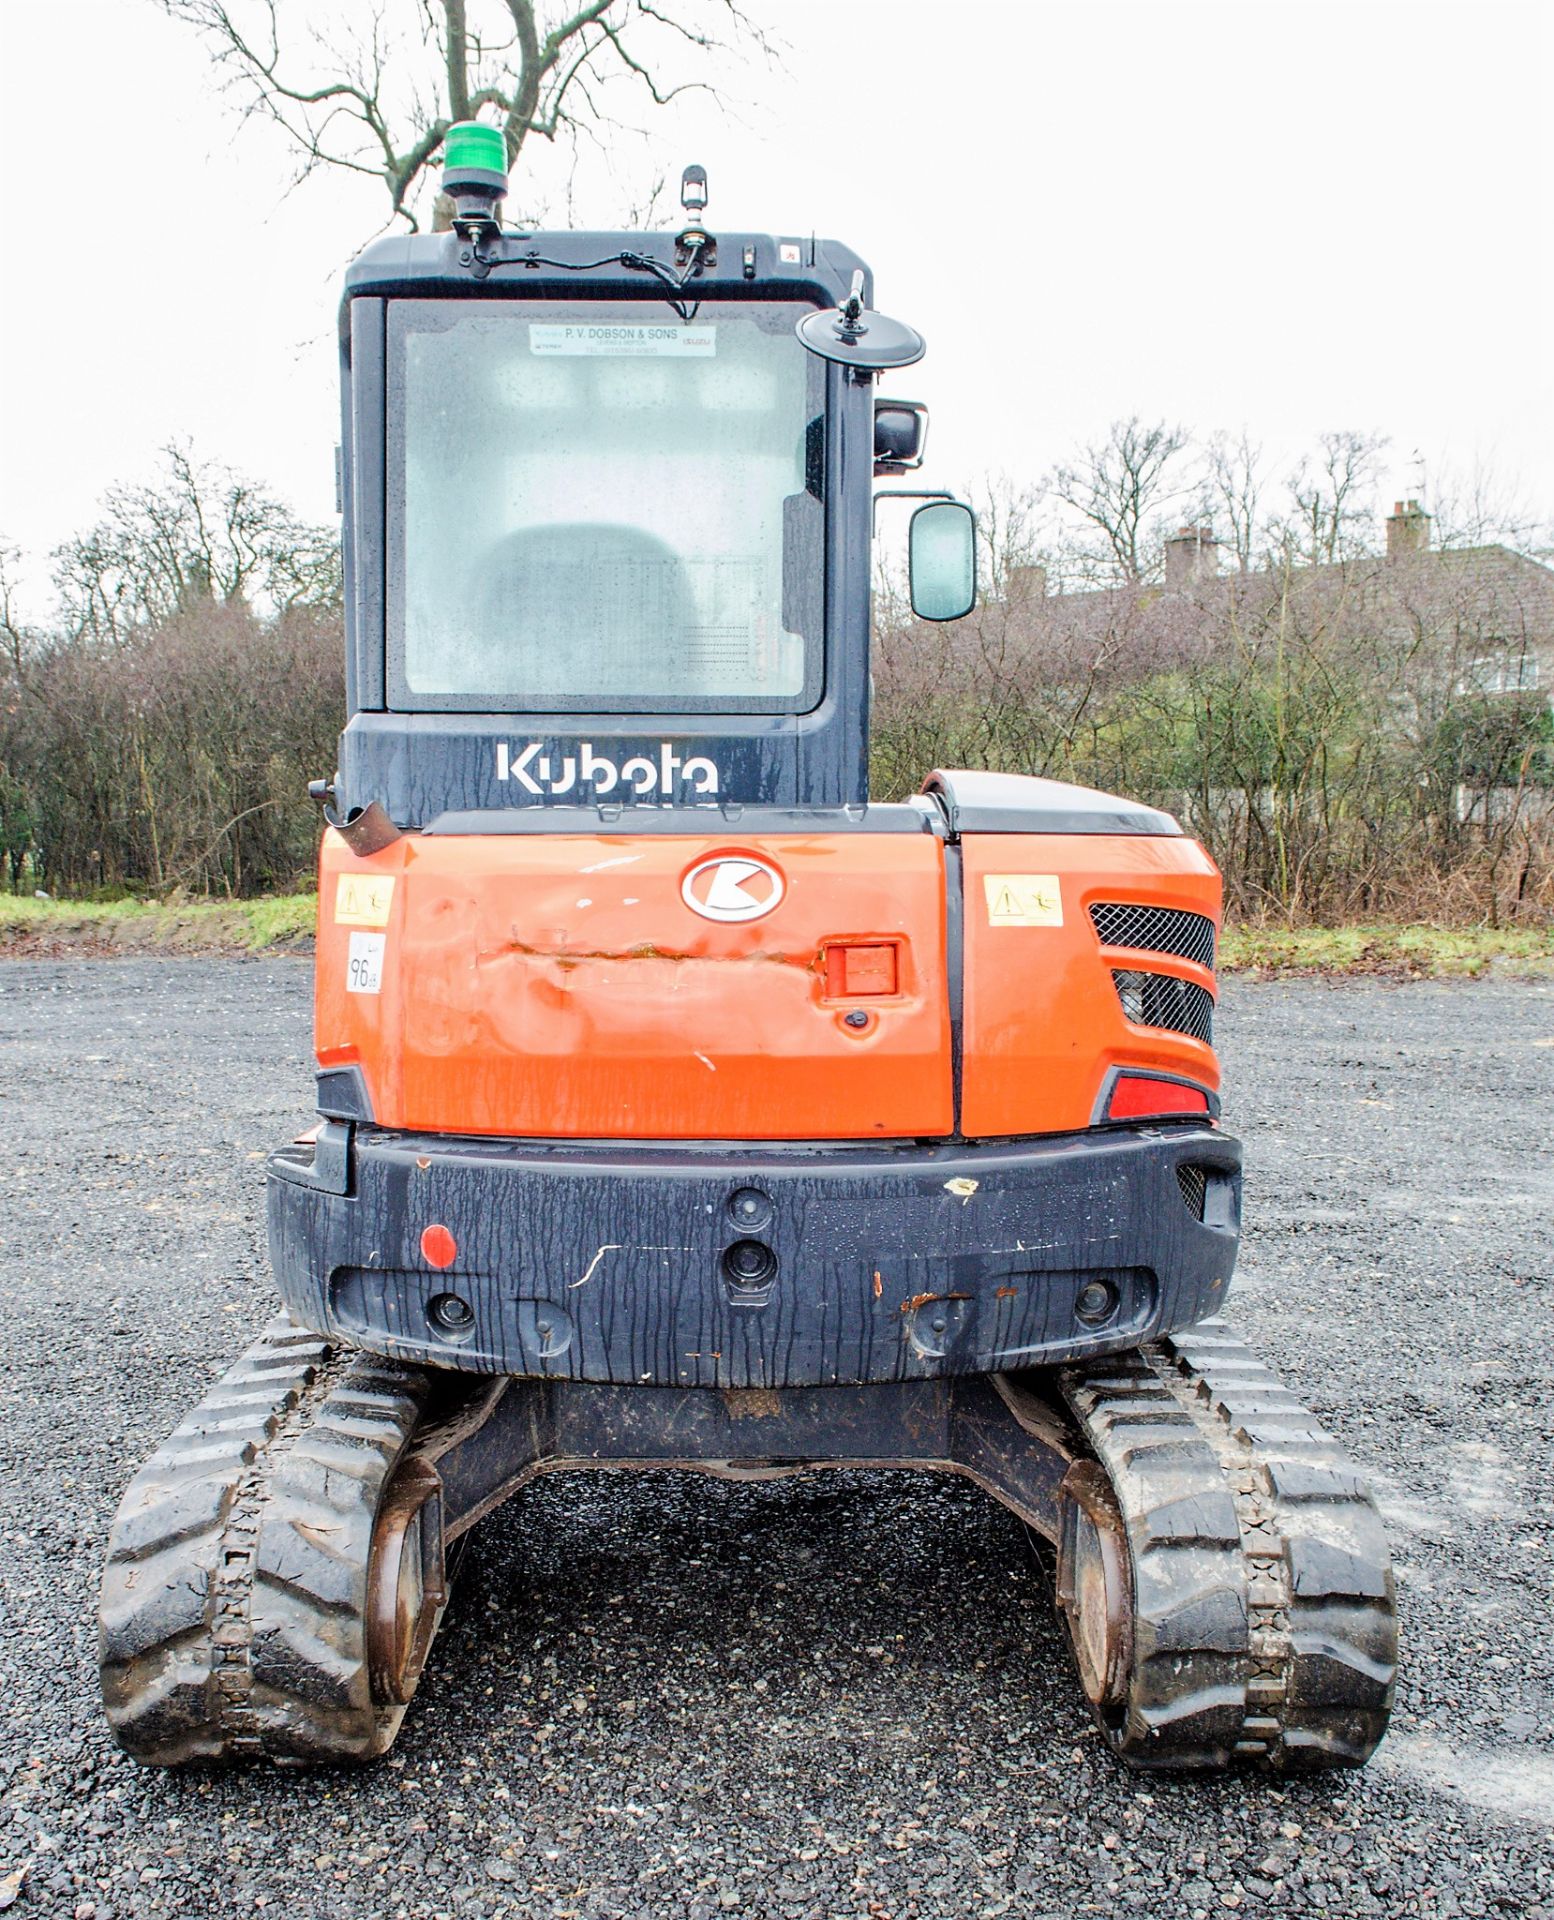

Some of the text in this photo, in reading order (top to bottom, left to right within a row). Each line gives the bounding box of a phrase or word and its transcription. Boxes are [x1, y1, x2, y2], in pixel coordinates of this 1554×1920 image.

[565, 328, 575, 339] P.
[576, 328, 586, 339] V.
[588, 328, 635, 340] DOBSON
[638, 329, 645, 339] &
[648, 329, 678, 340] SONS
[682, 338, 711, 346] ISUZU
[496, 743, 719, 795] Kubota
[350, 958, 369, 988] 96
